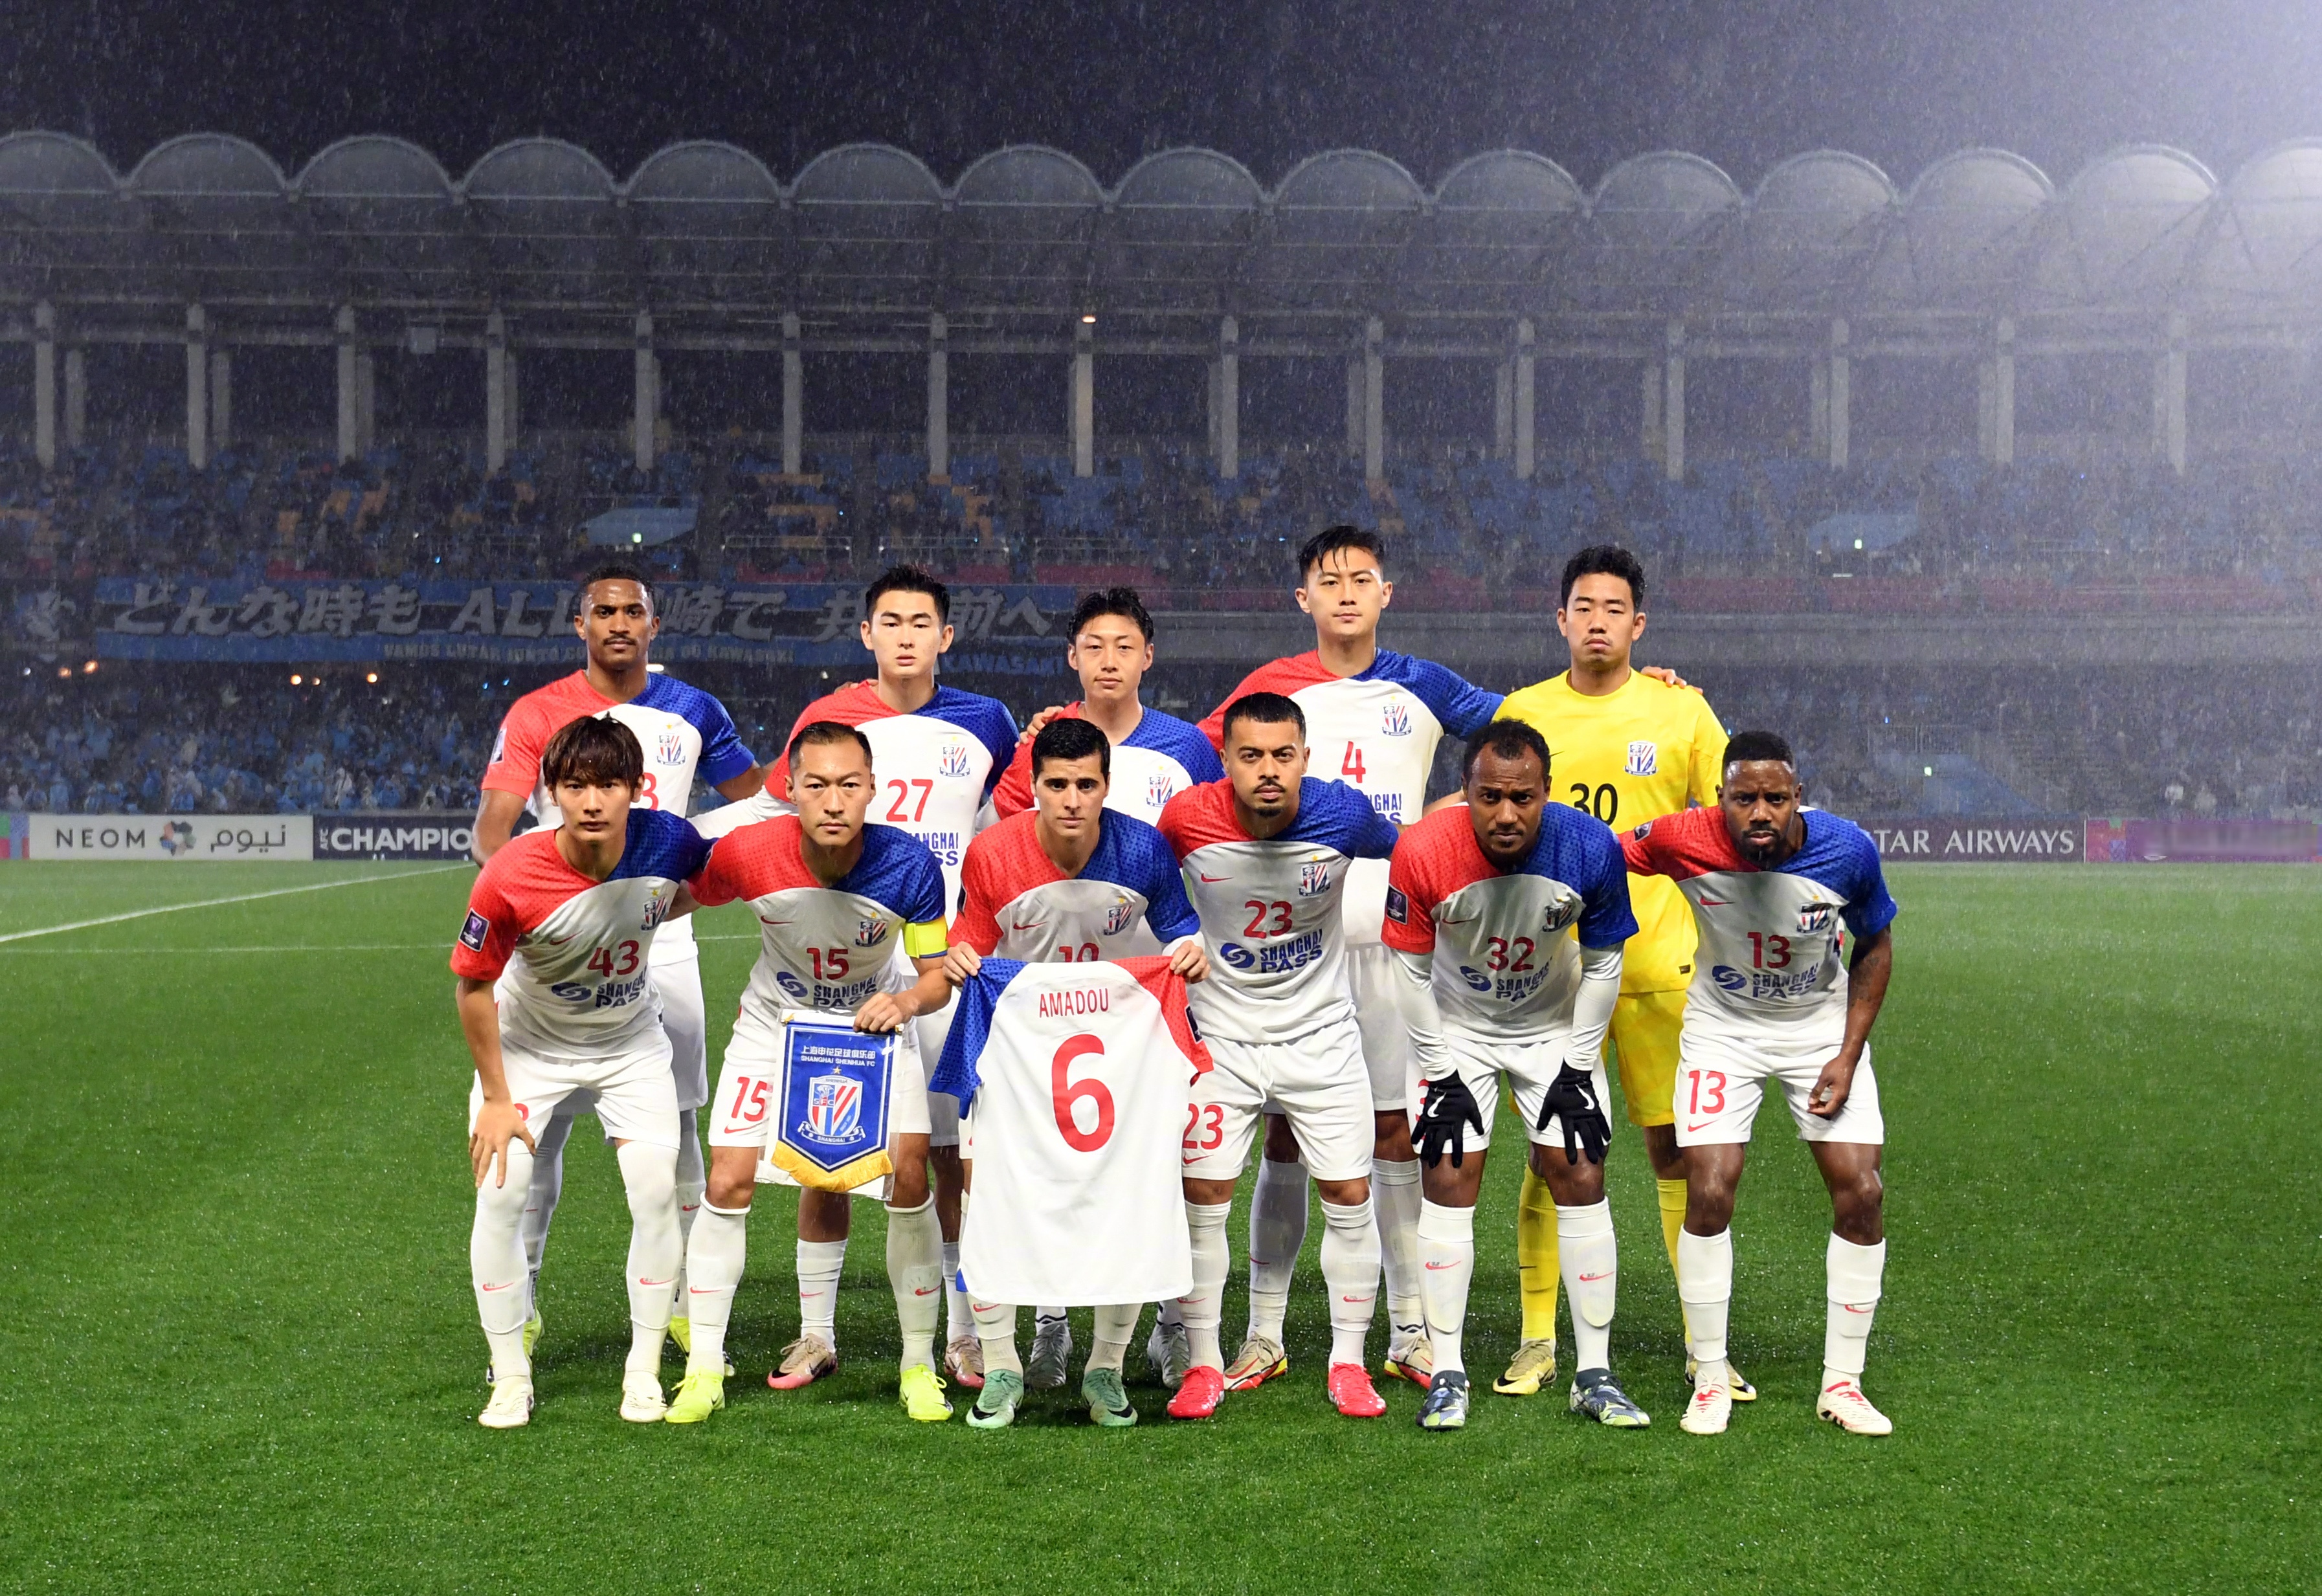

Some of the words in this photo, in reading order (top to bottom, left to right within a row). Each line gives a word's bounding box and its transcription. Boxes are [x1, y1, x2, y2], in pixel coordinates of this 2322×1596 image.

[114, 582, 421, 639] どんな時も
[1341, 741, 1366, 783] 4
[886, 779, 933, 822] 27
[1570, 783, 1618, 826] 30
[56, 828, 146, 848] NEOM
[210, 825, 286, 852] نيوم
[319, 828, 328, 850] AFC
[331, 827, 473, 851] CHAMPIO
[1873, 830, 1930, 854] TAR
[1945, 829, 2074, 854] AIRWAYS
[1244, 900, 1293, 938] 23
[587, 940, 640, 977] 43
[1260, 929, 1322, 961] SHANGHAI
[1261, 944, 1323, 973] PASS
[1486, 937, 1534, 971] 32
[1747, 932, 1791, 969] 13
[807, 948, 849, 980] 15
[1753, 962, 1818, 987] SHANGHAI
[814, 973, 878, 998] SHANGHAI
[1039, 988, 1110, 1019] AMADOU
[801, 1045, 876, 1059] 上海申花足球俱乐部
[801, 1055, 834, 1064] SHANGHAI
[835, 1058, 865, 1067] SHENHUA
[731, 1076, 770, 1122] 15
[1051, 1034, 1115, 1153] 6
[1689, 1070, 1726, 1114] 13
[817, 1134, 845, 1143] SHANGHAI
[1182, 1103, 1223, 1149] 23
